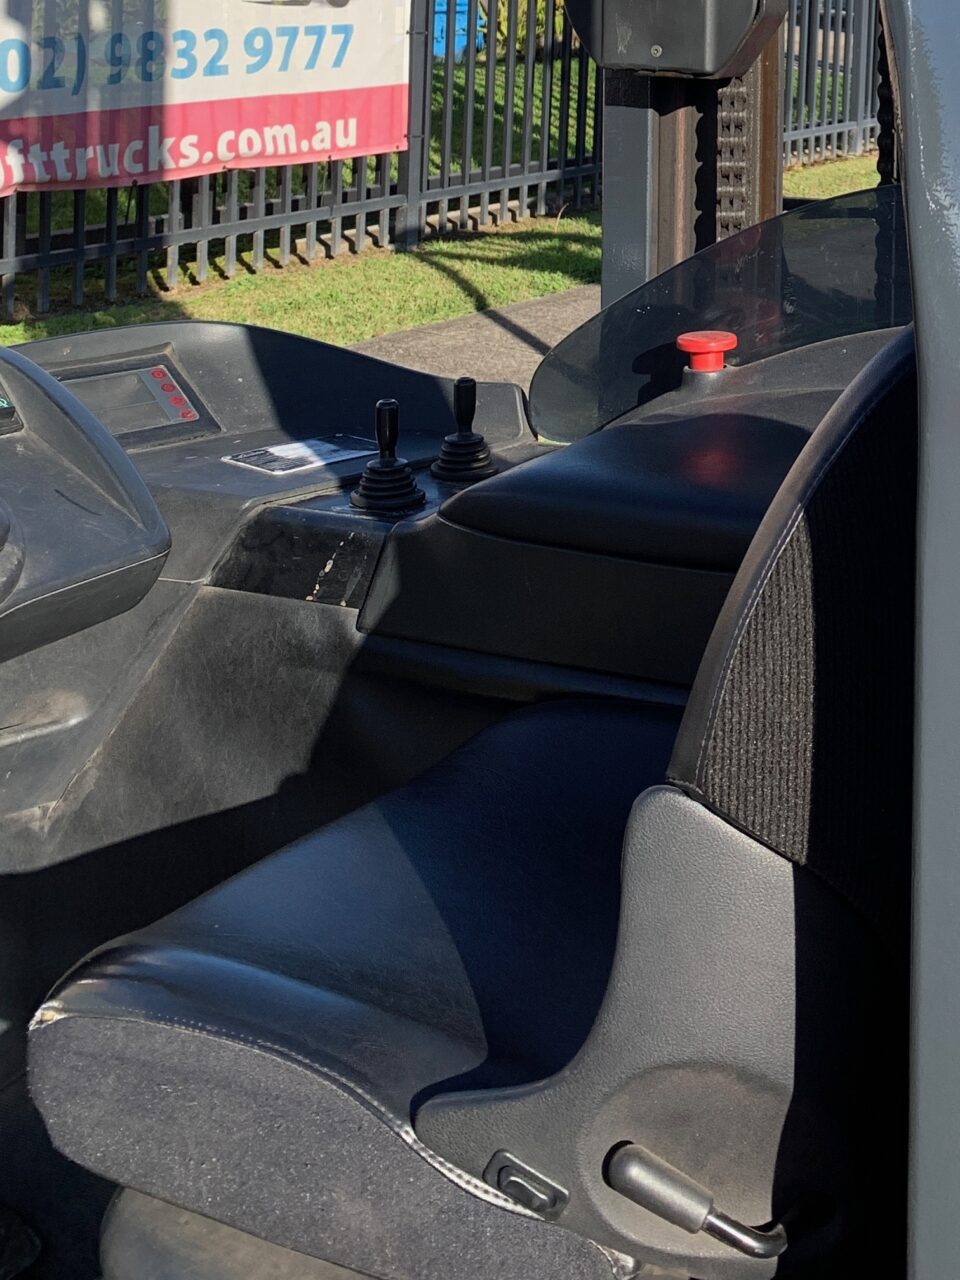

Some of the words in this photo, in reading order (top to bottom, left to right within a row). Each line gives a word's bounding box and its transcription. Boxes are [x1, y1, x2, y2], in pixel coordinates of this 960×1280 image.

[105, 27, 231, 86] 9832
[243, 23, 355, 75] 9777
[0, 117, 358, 188] fttrucks.com.au
